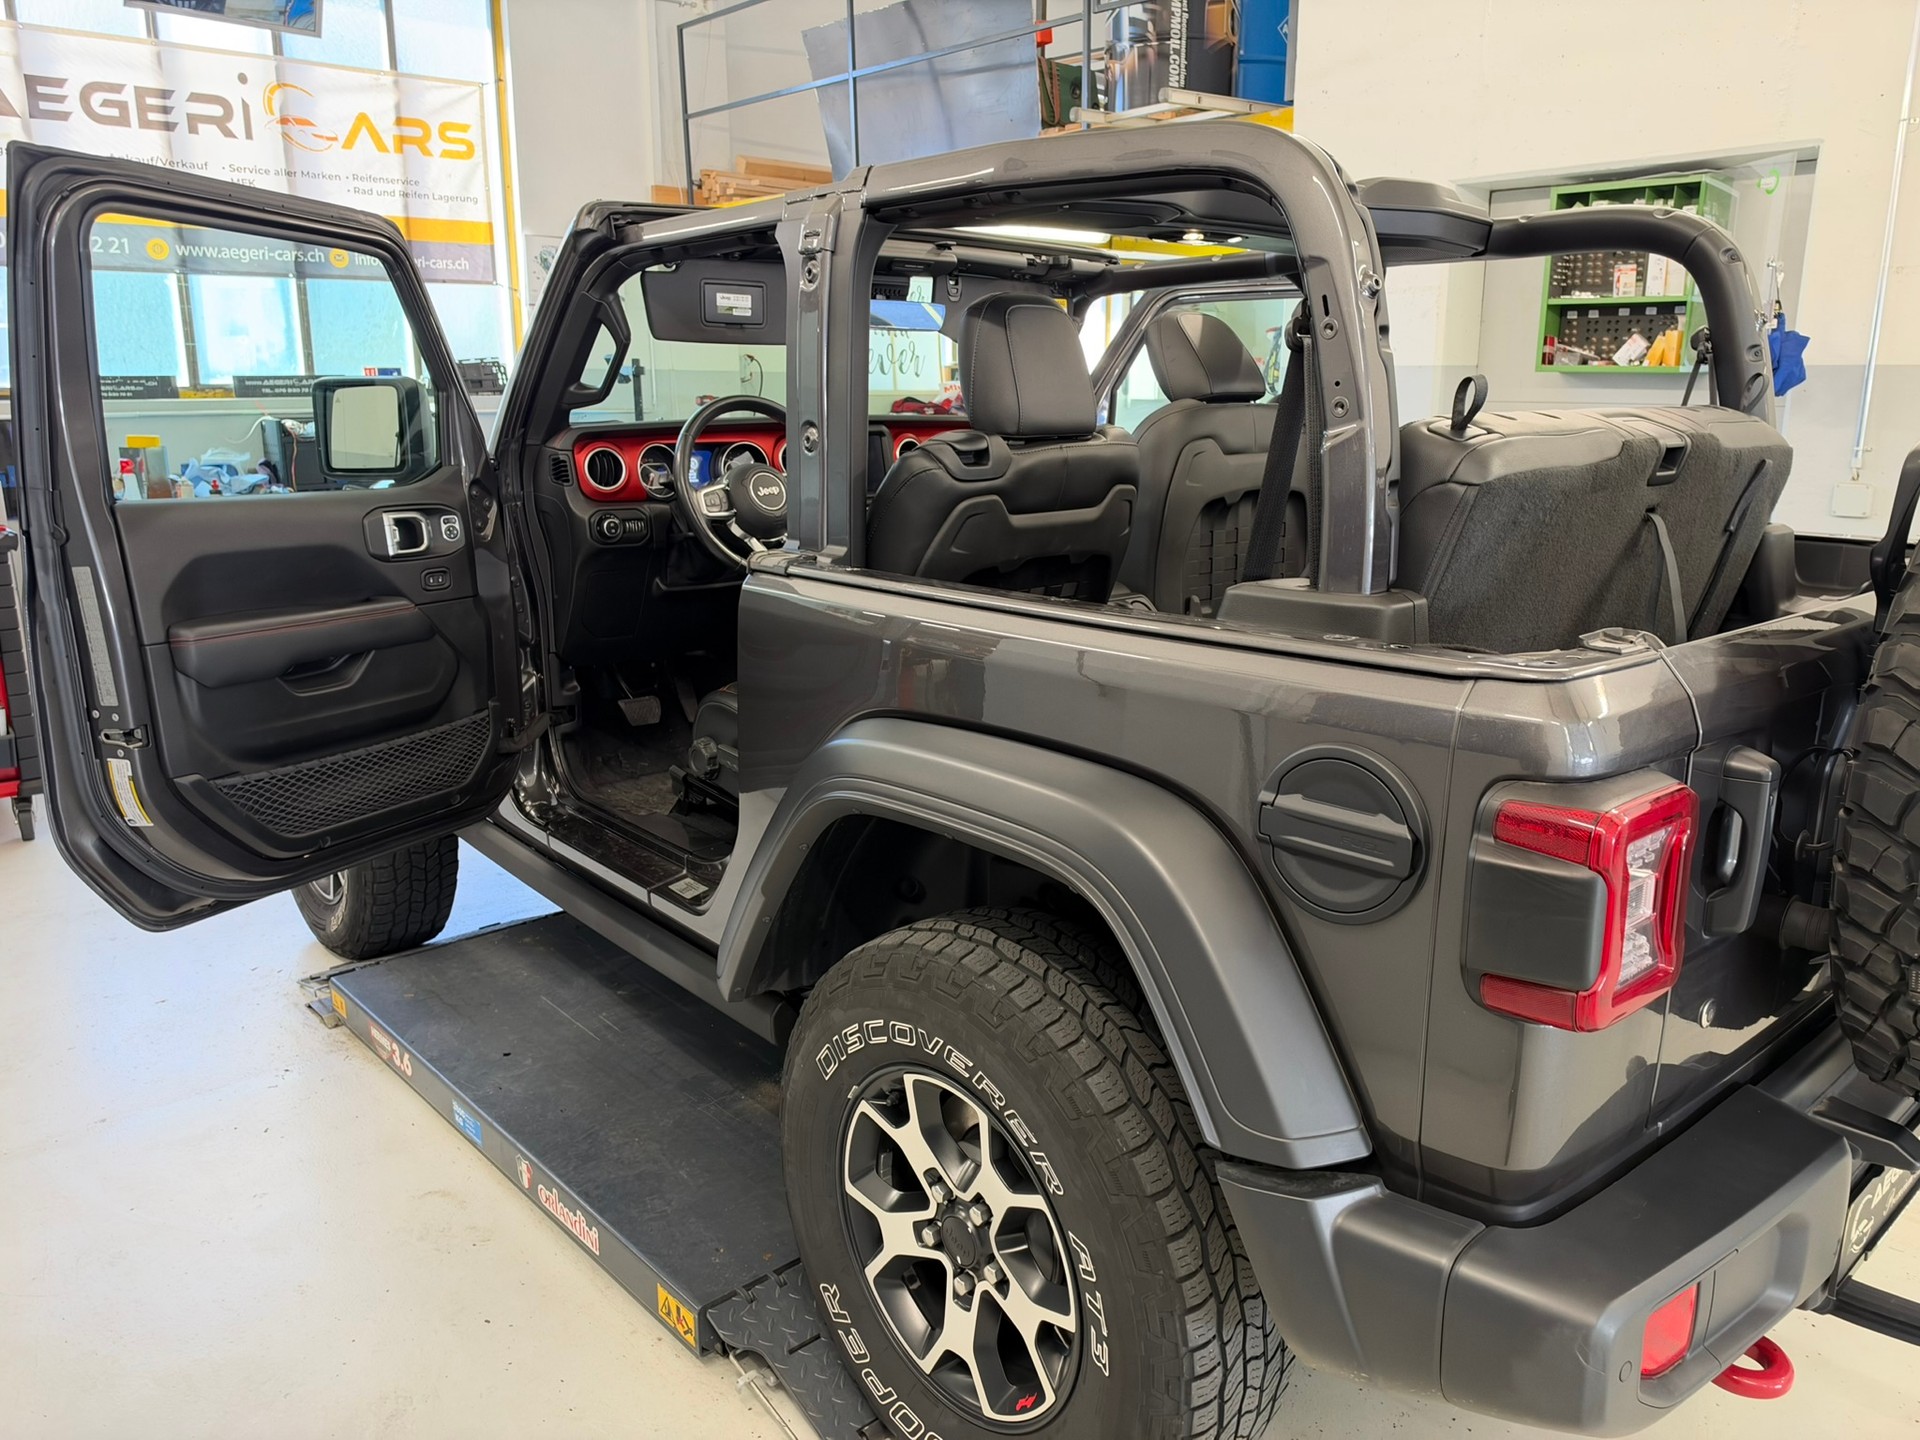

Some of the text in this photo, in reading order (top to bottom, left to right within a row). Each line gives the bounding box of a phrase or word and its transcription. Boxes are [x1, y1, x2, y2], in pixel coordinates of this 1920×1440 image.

[228, 163, 342, 182] Service aller Marken
[352, 174, 420, 187] Reifenservice
[353, 187, 478, 205] Rad und Reifen Lagerung
[108, 237, 130, 254] 21
[175, 242, 325, 264] www.aegeri-cars.ch
[757, 486, 780, 496] Jeep
[815, 1019, 1064, 1196] DISCOVERER
[1067, 1230, 1110, 1377] AT3
[819, 1283, 945, 1440] OPER
